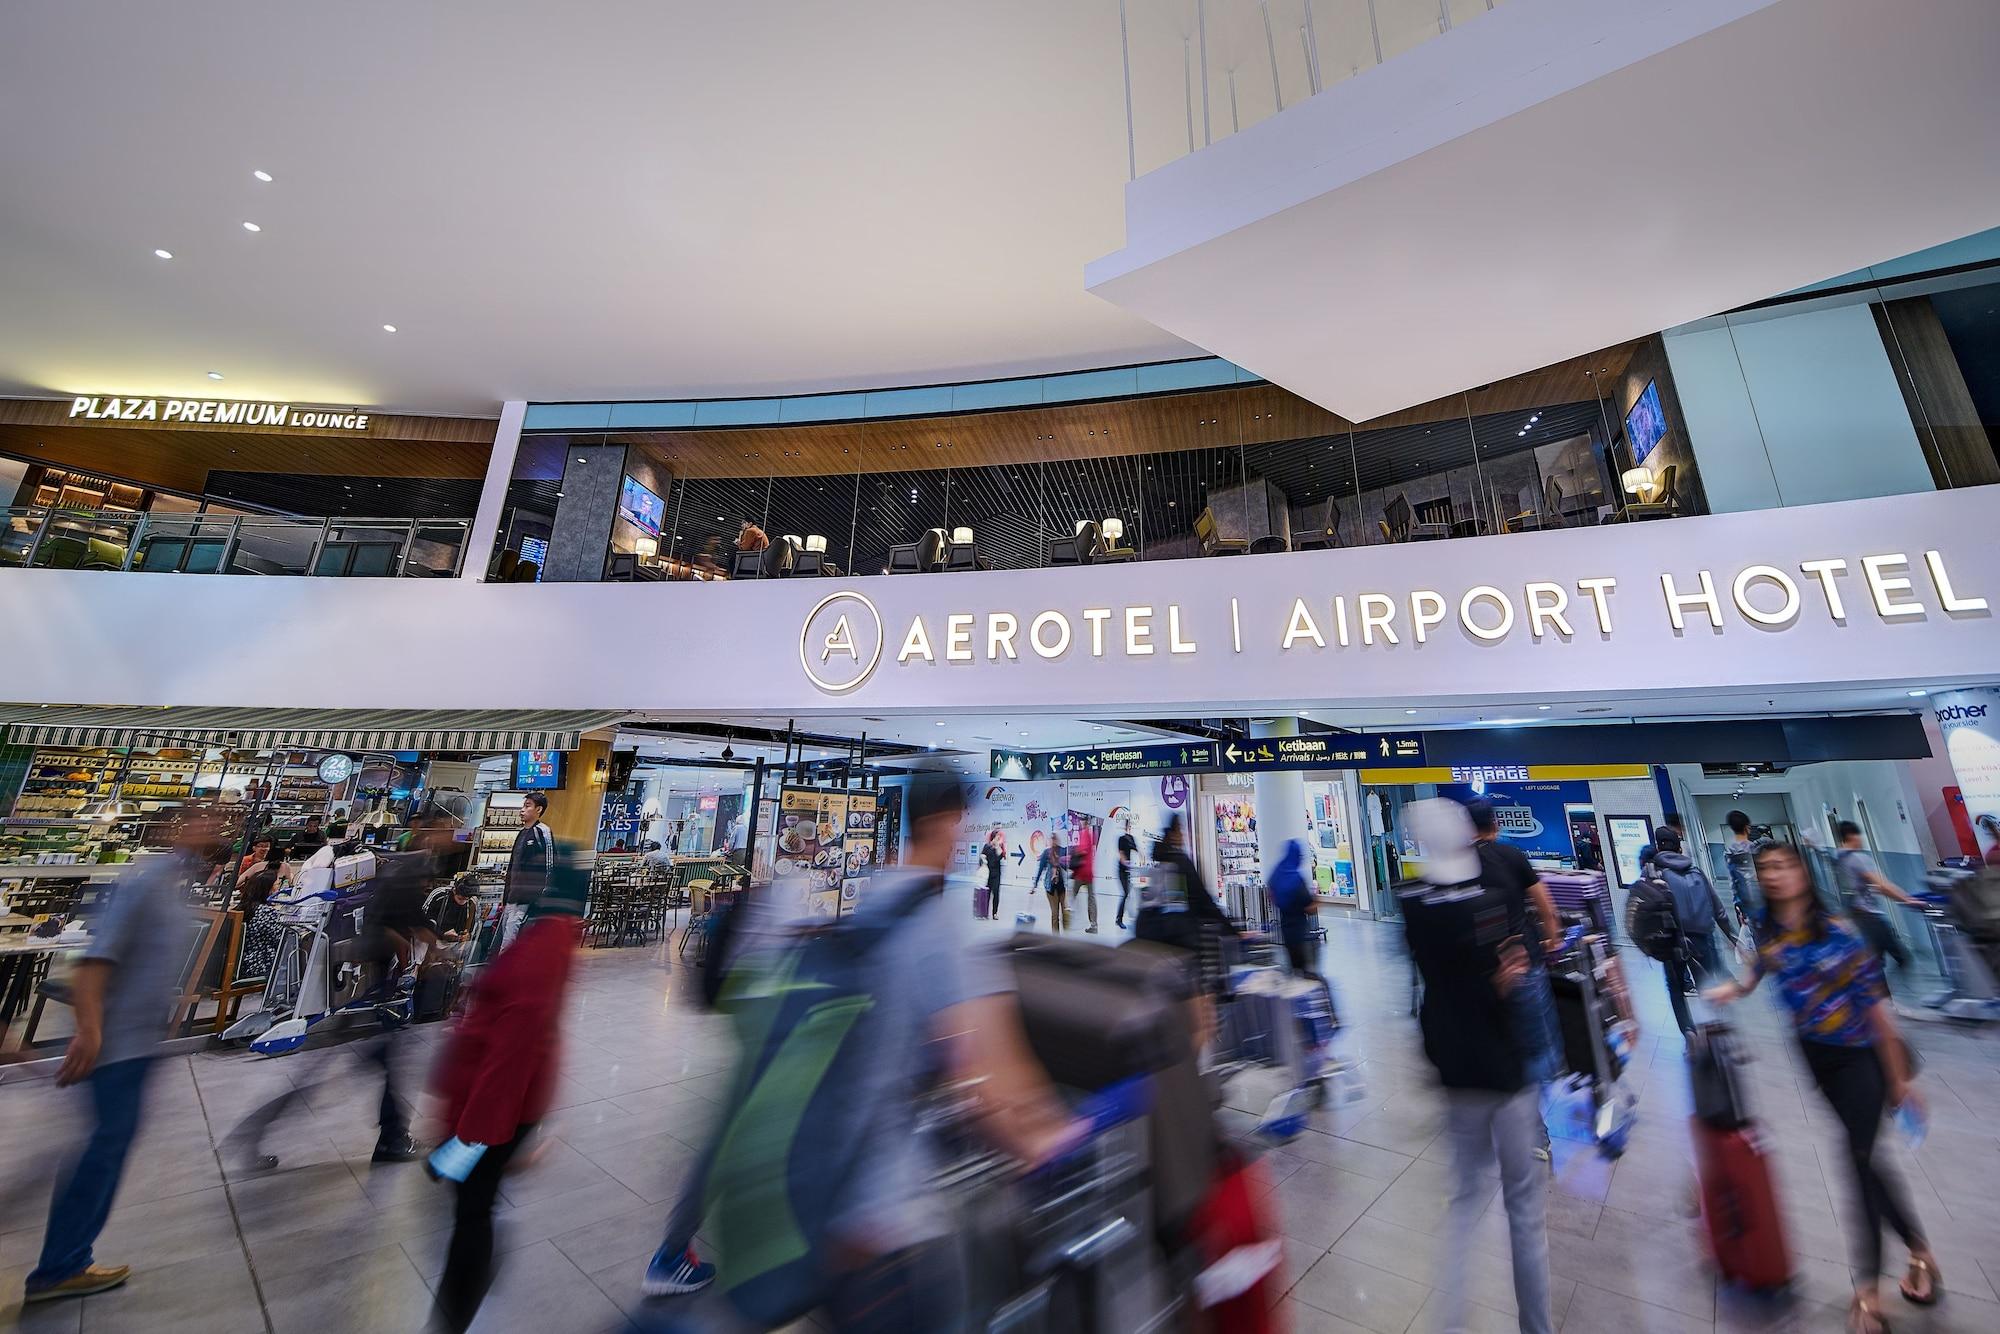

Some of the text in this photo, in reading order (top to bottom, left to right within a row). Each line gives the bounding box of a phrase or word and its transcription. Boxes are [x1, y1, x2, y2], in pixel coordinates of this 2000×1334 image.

[69, 397, 368, 430] PLAZA PREMIUM LOUNGE
[897, 605, 1197, 662] AEROTEL
[1282, 577, 1617, 650] AIRPORT
[1660, 550, 1989, 630] HOTEL
[1278, 739, 1326, 752] Ketibaan
[1101, 750, 1143, 763] Perlepasan
[1243, 750, 1256, 763] L2
[1279, 752, 1311, 762] Arrivals
[328, 758, 347, 770] 24
[1076, 761, 1085, 771] L3
[1101, 761, 1132, 771] Departures
[1451, 768, 1529, 782] STORAGE
